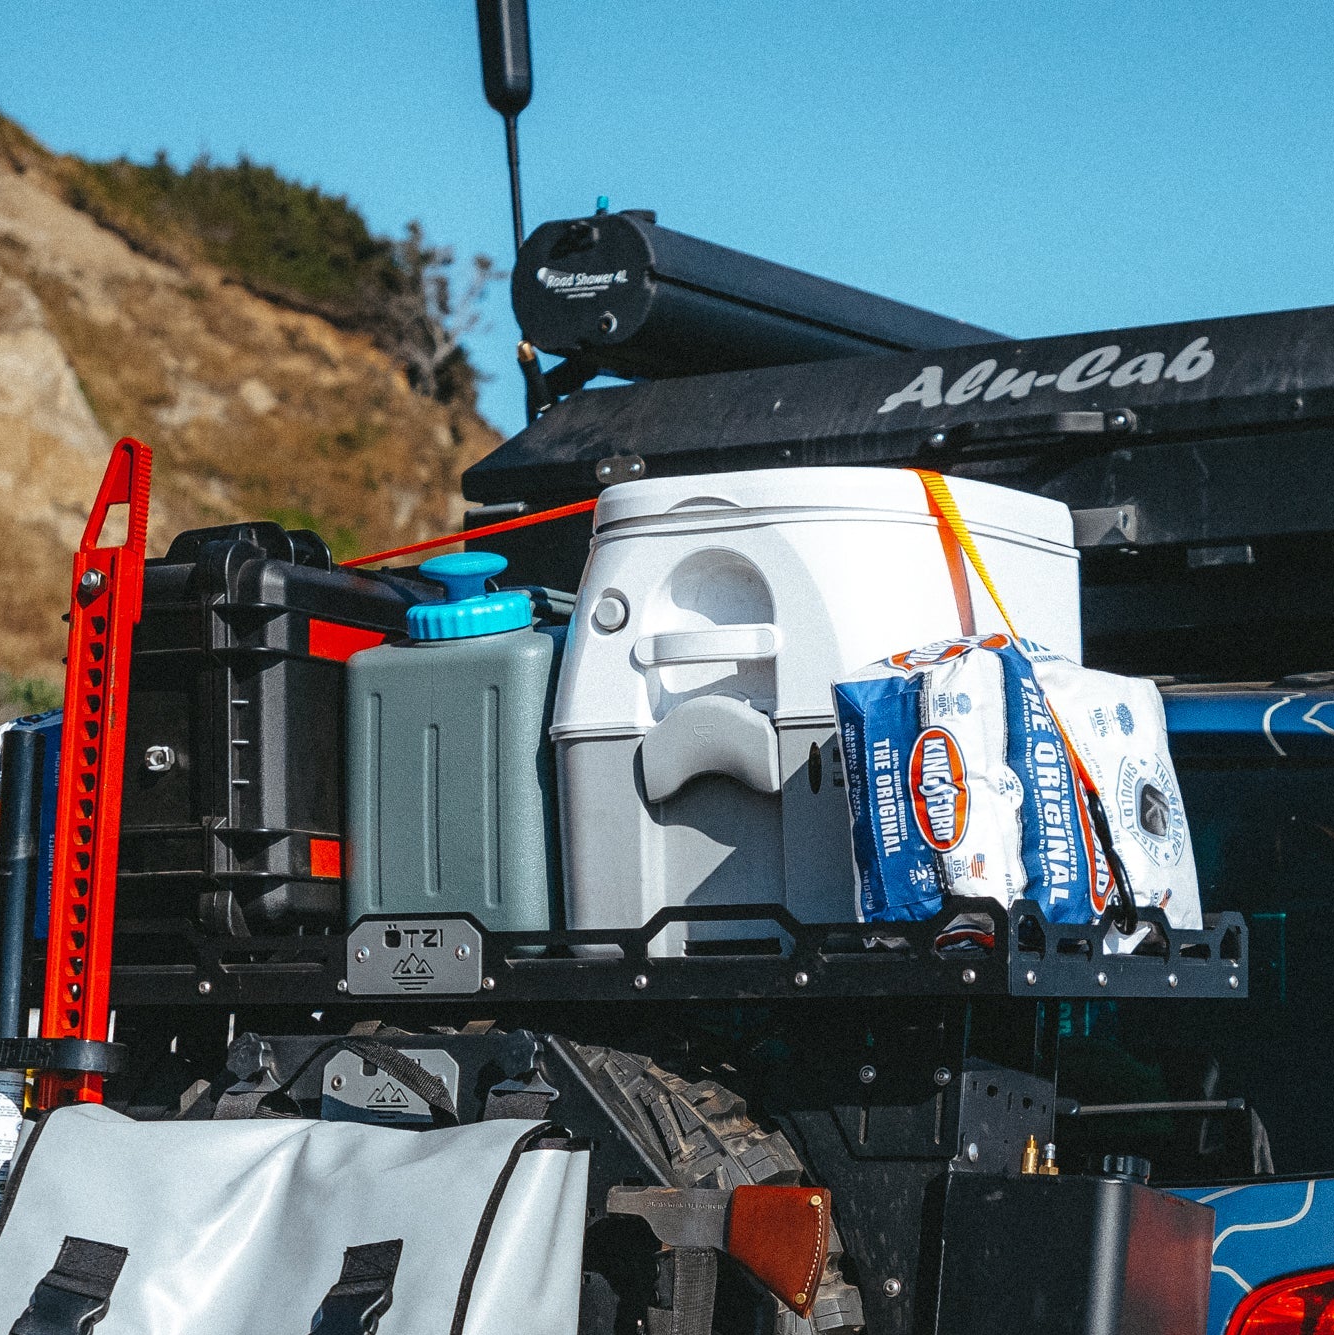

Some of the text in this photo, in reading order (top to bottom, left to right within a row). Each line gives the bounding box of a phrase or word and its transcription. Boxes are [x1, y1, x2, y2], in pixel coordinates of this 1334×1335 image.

[546, 272, 575, 289] Road
[575, 273, 615, 287] Shower
[877, 336, 1215, 413] Alu-Cab
[938, 692, 948, 718] 100%
[1020, 677, 1052, 733] THE
[1093, 706, 1106, 738] 100%
[893, 770, 905, 799] NATURAL
[919, 737, 960, 842] KINGSFORD
[1155, 761, 1171, 789] THE
[873, 738, 902, 857] THE ORIGINAL
[1056, 740, 1078, 882] NATURAL INGREDIENTS
[1121, 762, 1160, 857] SHOULD TASTE
[897, 799, 909, 841] INGREDIENTS
[1035, 741, 1069, 905] ORIGINAL
[916, 869, 928, 881] 2
[953, 859, 963, 880] USA
[382, 924, 444, 949] ÖTZI
